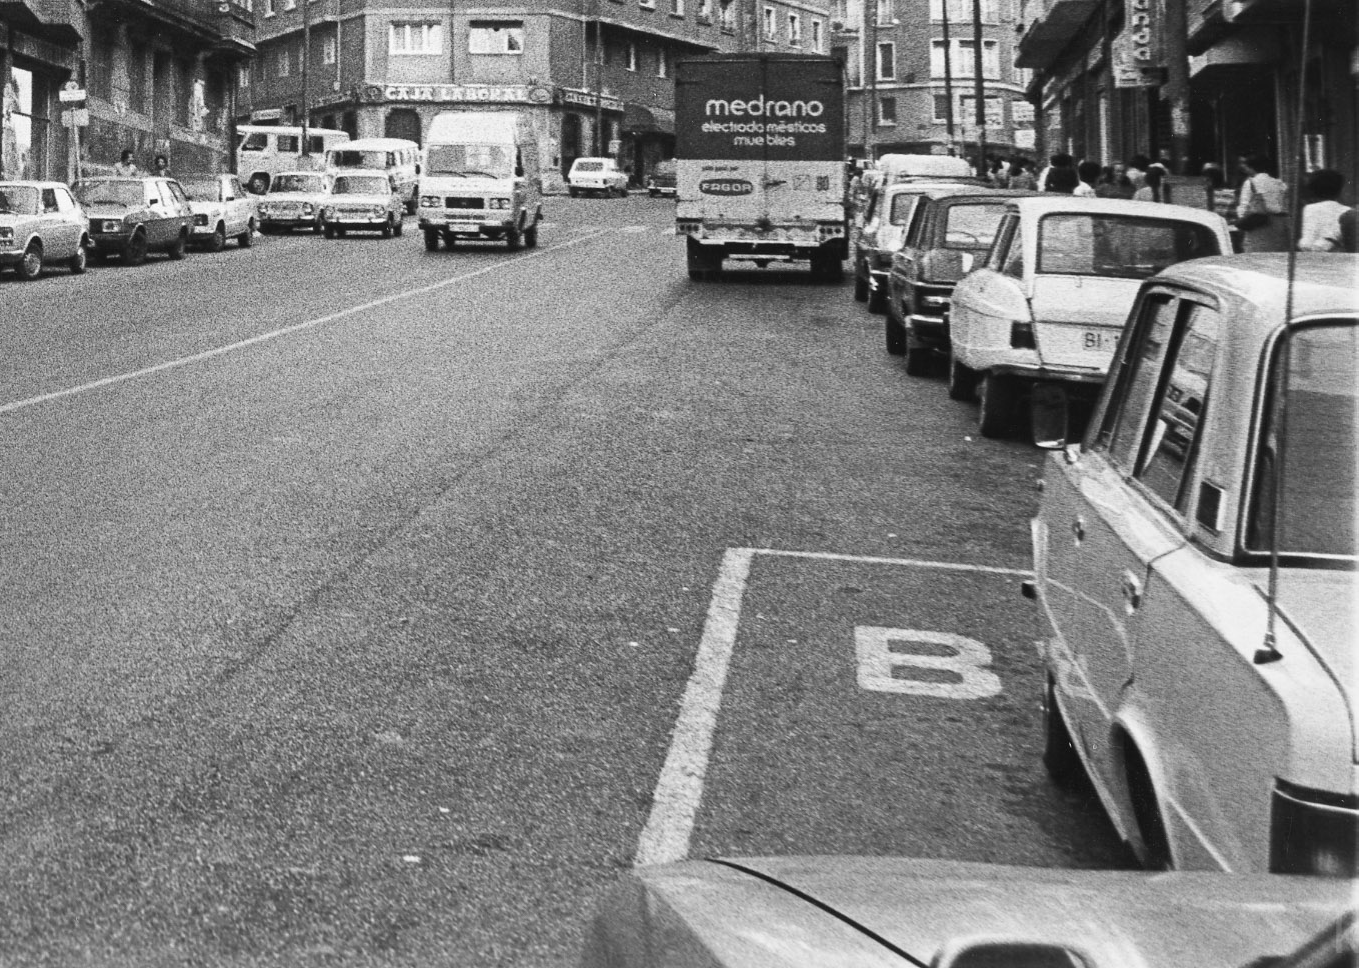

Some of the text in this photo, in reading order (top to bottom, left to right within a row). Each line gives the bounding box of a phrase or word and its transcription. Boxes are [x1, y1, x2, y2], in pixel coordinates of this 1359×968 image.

[385, 86, 529, 102] CAJA LABORAL
[705, 93, 824, 117] medrano
[701, 182, 753, 193] FAGOR
[854, 625, 1004, 701] B
